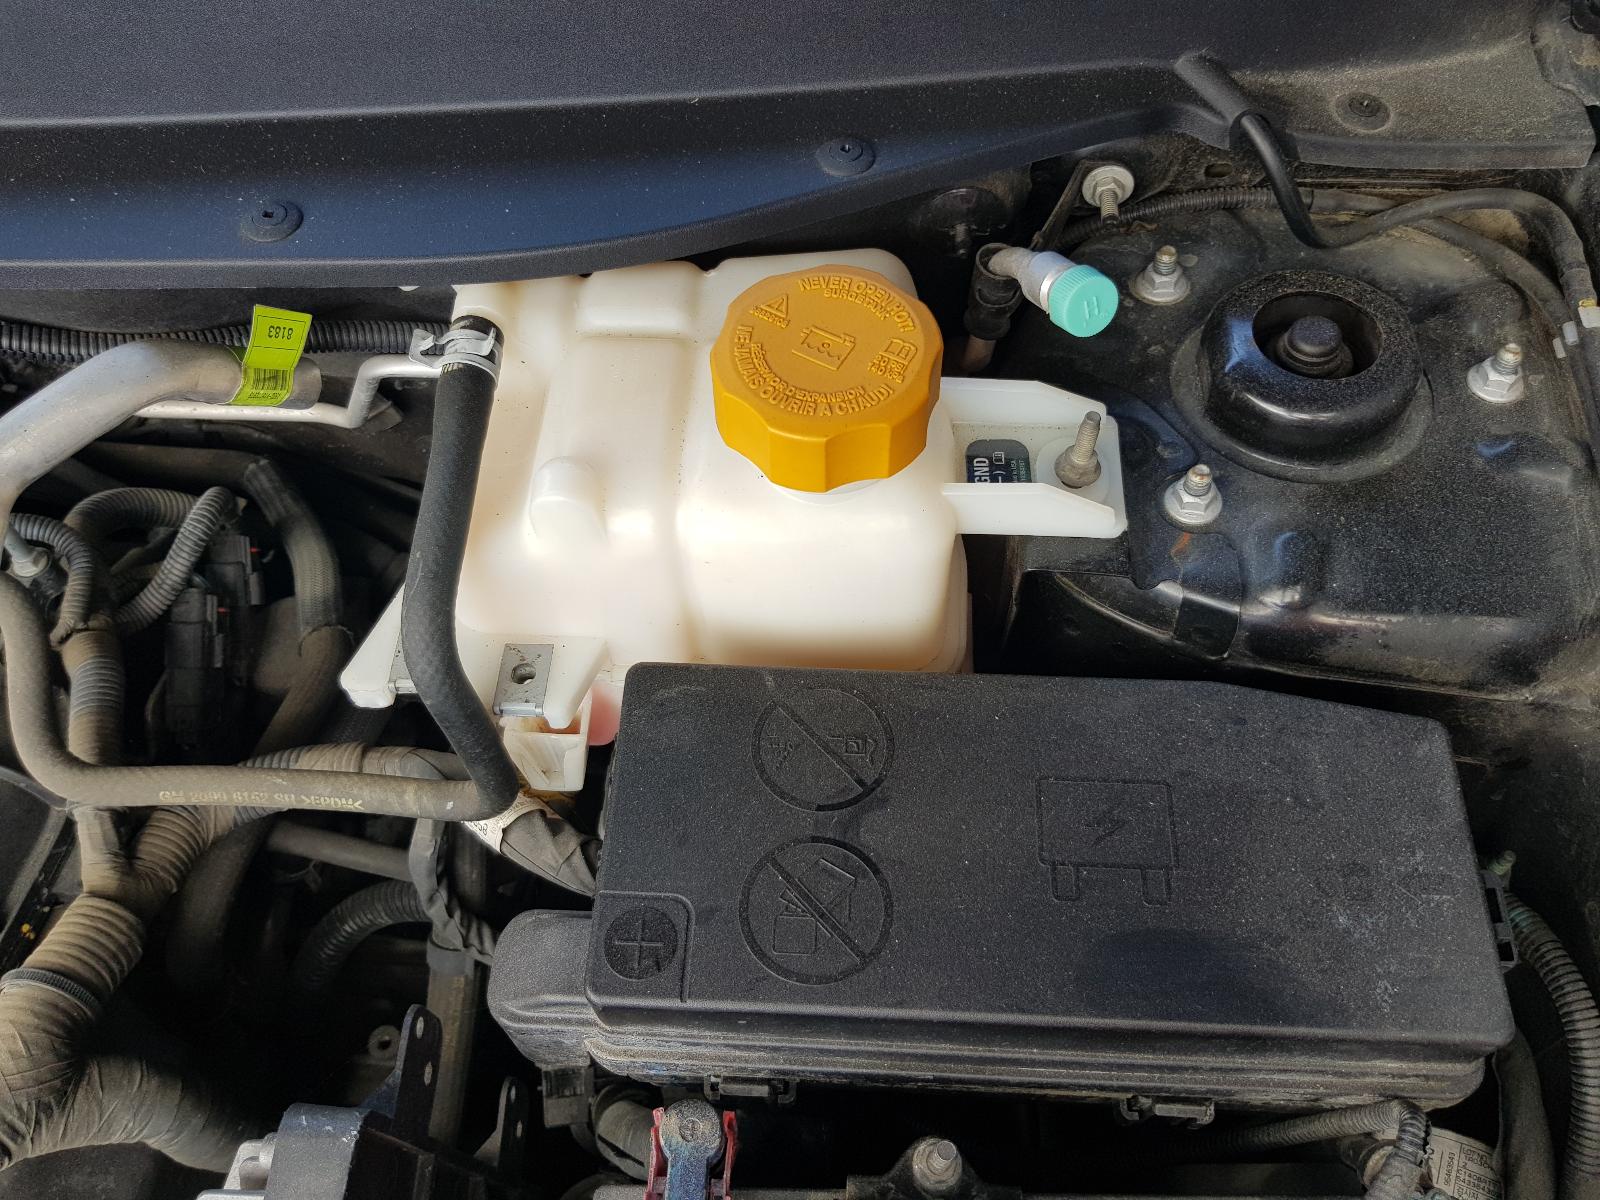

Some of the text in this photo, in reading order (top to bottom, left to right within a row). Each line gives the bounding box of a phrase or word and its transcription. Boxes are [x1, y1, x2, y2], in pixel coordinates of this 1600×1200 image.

[799, 275, 851, 292] NEVER
[856, 279, 893, 305] OPEN
[824, 288, 865, 304] SURGE
[267, 325, 294, 341] 8183
[760, 385, 817, 416] OUVRIR
[973, 457, 990, 483] GND
